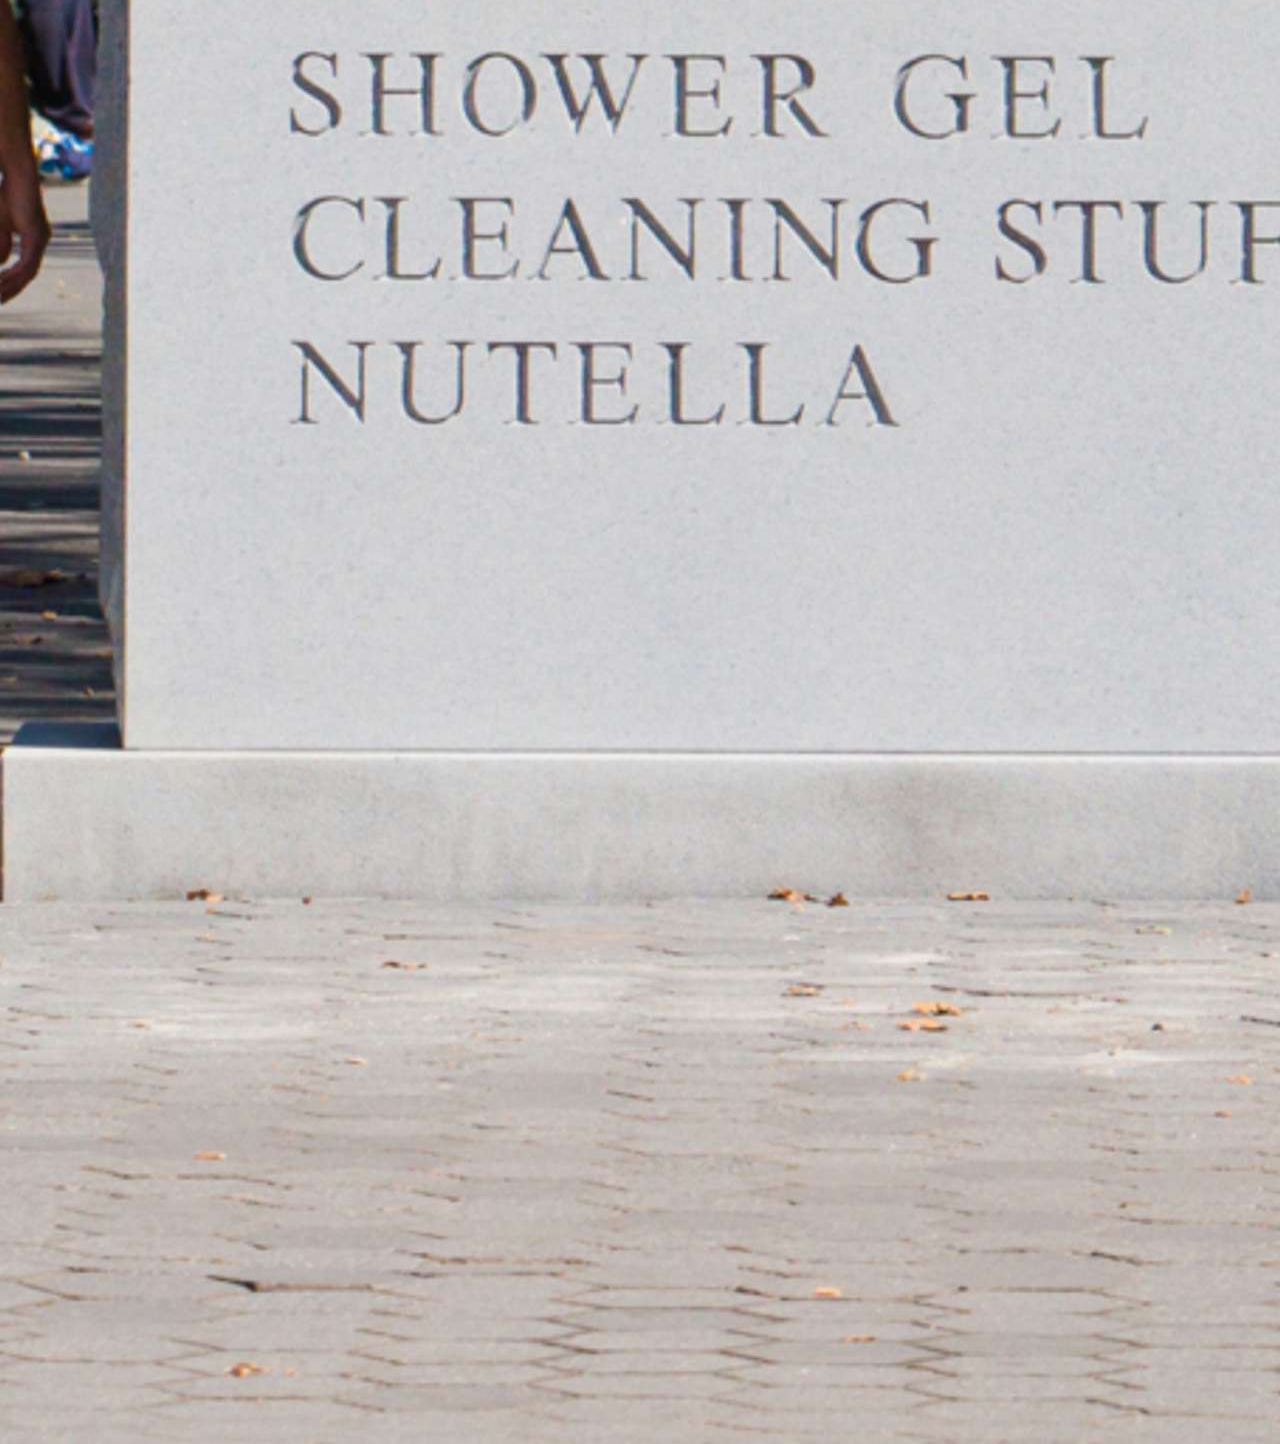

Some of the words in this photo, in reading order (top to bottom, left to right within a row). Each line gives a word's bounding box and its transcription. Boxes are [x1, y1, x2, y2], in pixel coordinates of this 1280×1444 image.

[289, 50, 830, 138] SHOWER
[893, 53, 1149, 140] GEL
[292, 195, 940, 285] CLEANING
[290, 339, 900, 428] NUTELLA
